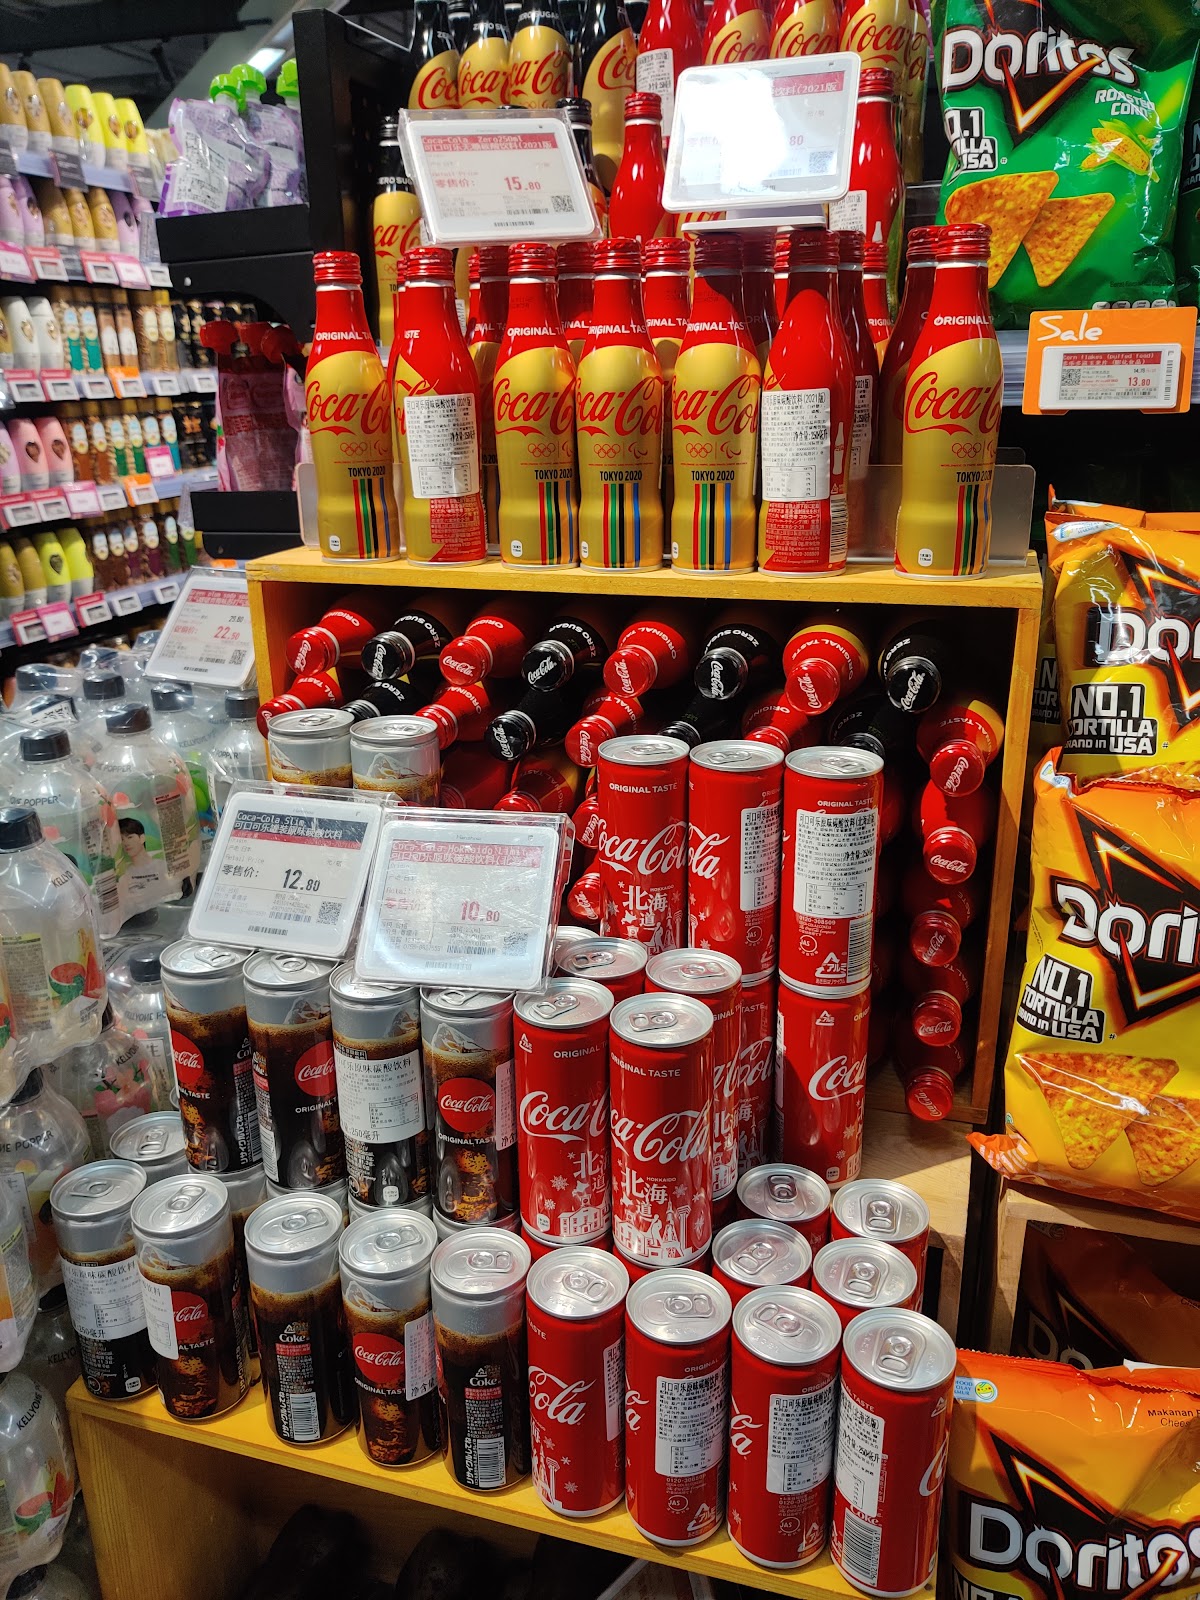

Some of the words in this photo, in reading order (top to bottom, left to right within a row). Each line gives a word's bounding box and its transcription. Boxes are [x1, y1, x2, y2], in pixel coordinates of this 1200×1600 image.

[942, 25, 1136, 89] Doritos
[1095, 88, 1156, 112] ROASTED
[422, 136, 469, 144] Coca-Cola
[503, 175, 542, 191] 15.80
[933, 315, 990, 327] ORIGINAL
[1037, 312, 1103, 342] Sale
[315, 331, 363, 342] ORIGINAL
[507, 326, 555, 337] ORIGINAL
[1127, 376, 1151, 387] 13.80
[347, 467, 372, 478] TOKYO
[534, 469, 559, 480] TOKYO
[599, 470, 624, 481] TOKYO
[624, 470, 643, 481] 2020
[690, 470, 716, 481] TOKYO
[716, 470, 735, 481] 2020
[956, 471, 981, 483] TOKYO
[424, 622, 441, 649] ZERO
[732, 629, 760, 648] ZERO
[582, 630, 596, 658] ZERO
[886, 637, 911, 661] ZERO
[820, 638, 854, 681] ORIGINAL
[381, 681, 406, 702] ZERO
[1072, 685, 1143, 719] NO.1
[1094, 738, 1107, 749] in
[1109, 736, 1153, 754] USA
[103, 764, 133, 773] POPPER
[609, 783, 651, 794] ORIGINAL
[652, 782, 678, 793] TASTE
[23, 796, 59, 806] POPPER
[817, 799, 854, 808] ORIGINAL
[236, 812, 281, 824] Coca-Cola
[284, 815, 307, 828] Slim
[930, 854, 969, 874] Coca-Cola
[221, 864, 260, 878] 零售价:
[282, 867, 321, 893] 12.80
[459, 900, 500, 923] 10.80
[1032, 955, 1090, 1008] NO.1
[1022, 985, 1101, 1028] TORTILLA
[1037, 1020, 1050, 1031] in
[1051, 1020, 1099, 1042] USA
[553, 1046, 600, 1059] ORIGINAL
[647, 1068, 682, 1078] TASTE
[188, 1091, 211, 1100] TASTE
[295, 1101, 333, 1114] ORIGINAL
[440, 1093, 494, 1113] Coca-Cola
[15, 1130, 54, 1152] POPPER
[438, 1132, 475, 1146] ORIGINAL
[187, 1337, 215, 1351] TASTE
[278, 1333, 306, 1343] Coke
[354, 1345, 405, 1367] Coca-Cola
[684, 1359, 719, 1373] ORIGINAL
[354, 1376, 386, 1396] ORIGINAL
[469, 1377, 498, 1387] Coke
[1147, 1409, 1194, 1417] Makanan
[668, 1499, 681, 1507] JAS
[780, 1521, 793, 1529] JAS
